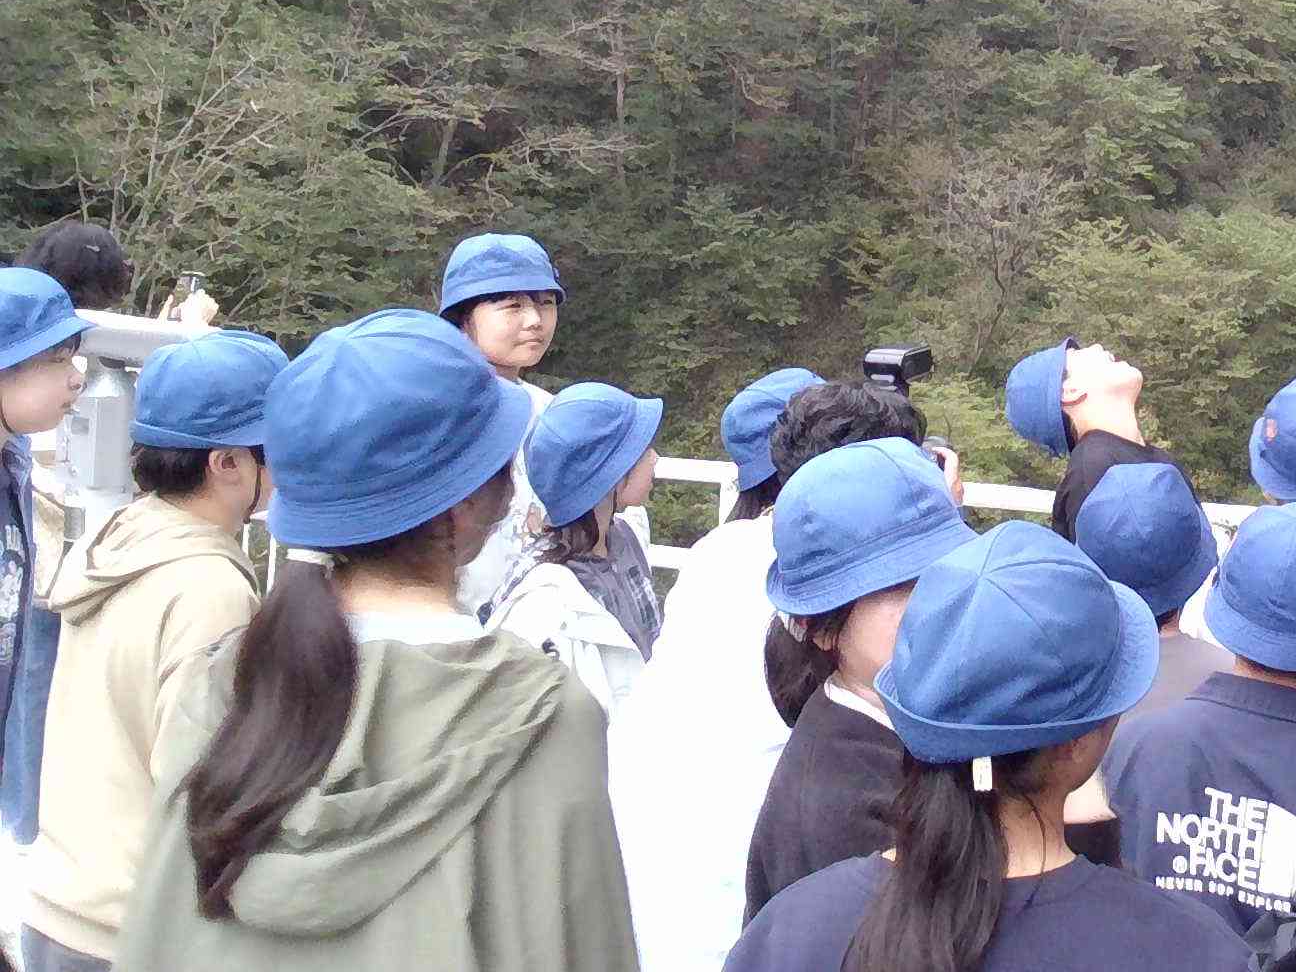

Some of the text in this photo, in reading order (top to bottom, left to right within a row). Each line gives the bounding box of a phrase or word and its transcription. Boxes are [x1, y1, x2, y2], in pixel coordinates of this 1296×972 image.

[1204, 786, 1268, 831] THE
[1156, 811, 1262, 860] NORTH
[1155, 876, 1203, 892] NEVER
[1189, 843, 1258, 890] FACE
